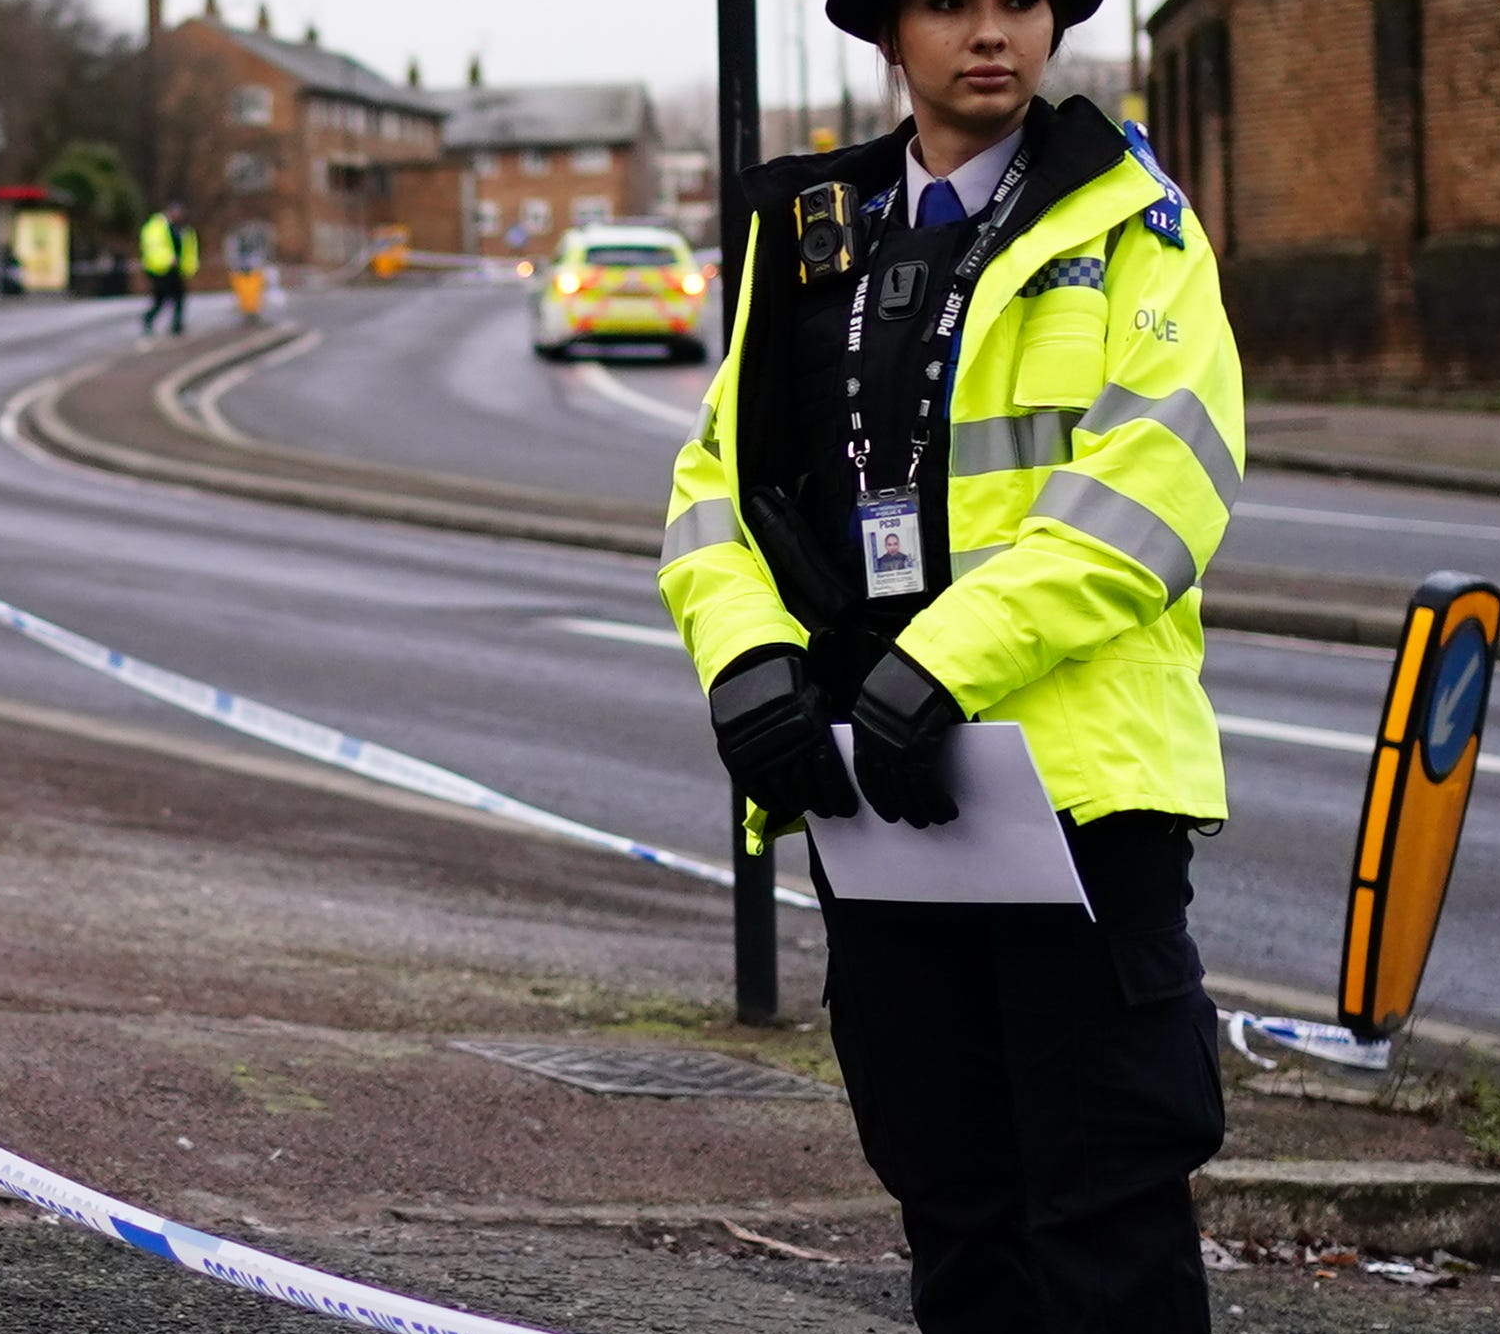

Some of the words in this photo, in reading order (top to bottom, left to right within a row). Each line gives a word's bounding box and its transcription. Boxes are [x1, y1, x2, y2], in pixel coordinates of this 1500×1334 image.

[851, 273, 870, 315] POLICE
[936, 291, 965, 337] POLICE
[847, 315, 863, 352] STAFF
